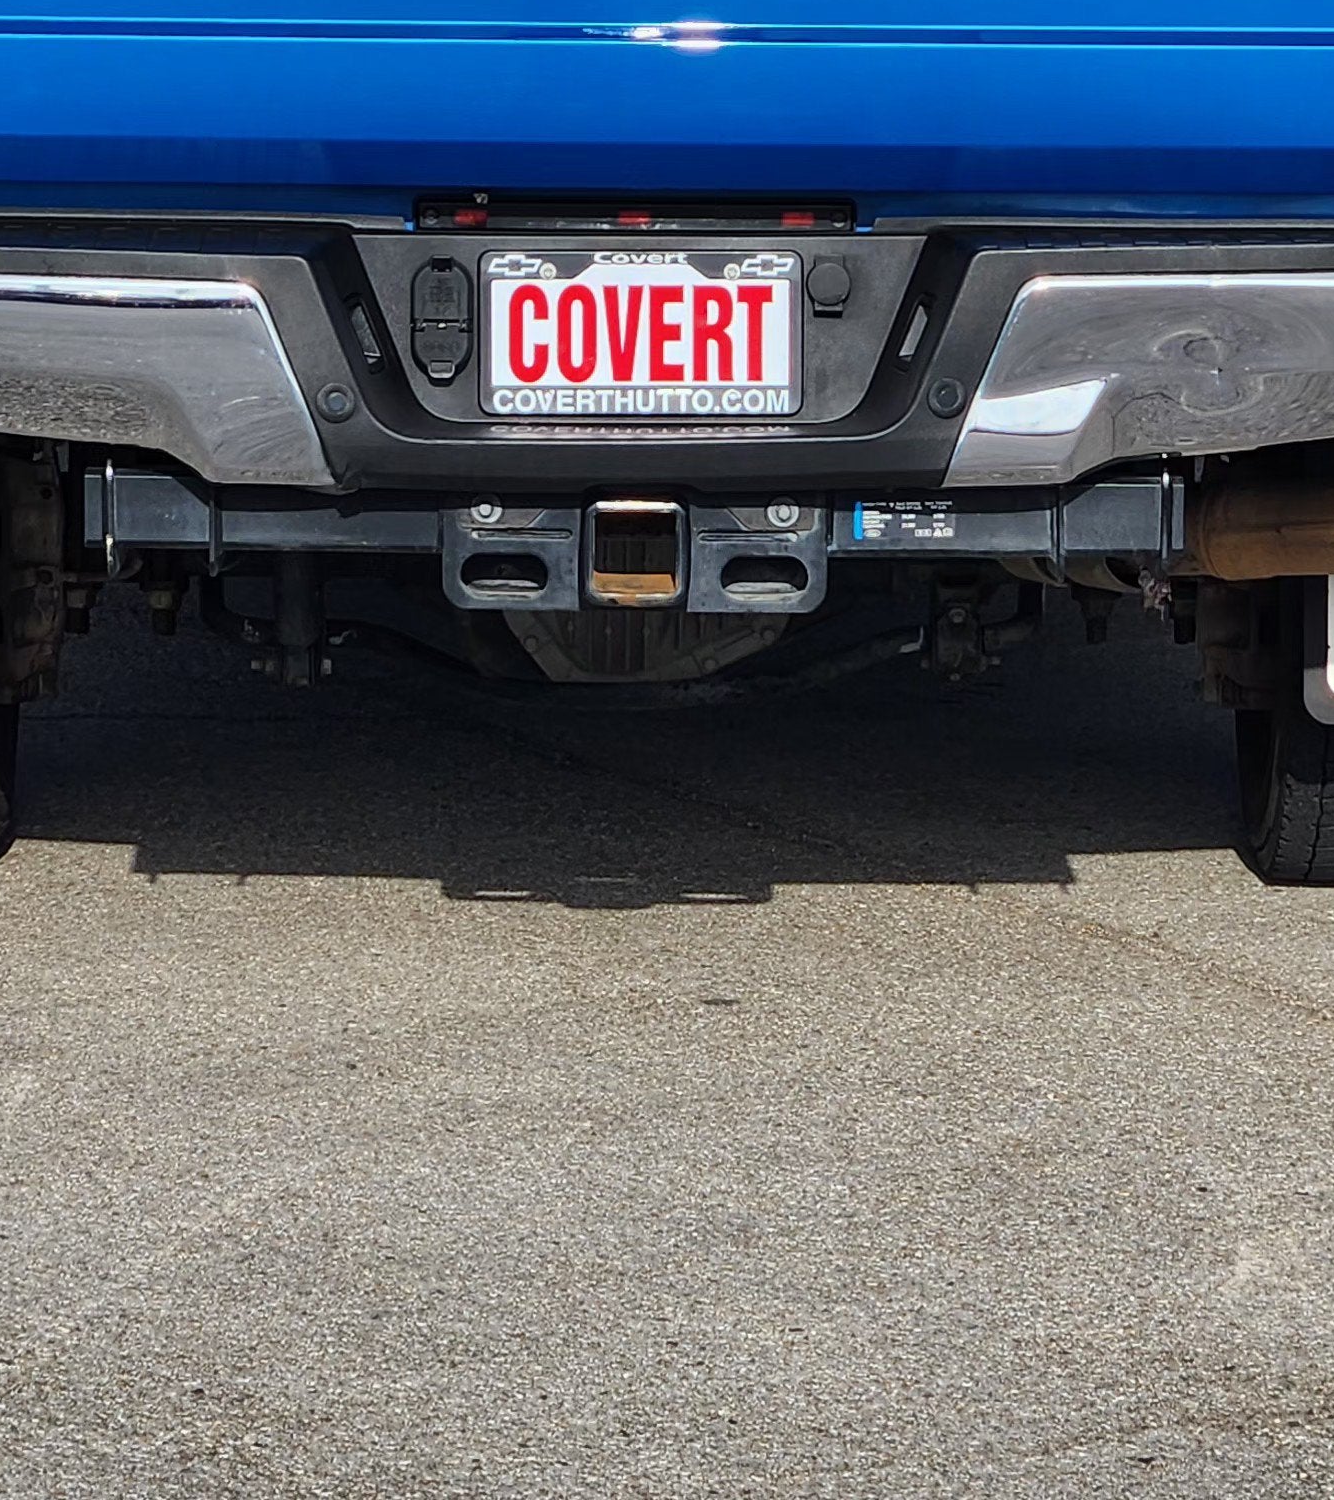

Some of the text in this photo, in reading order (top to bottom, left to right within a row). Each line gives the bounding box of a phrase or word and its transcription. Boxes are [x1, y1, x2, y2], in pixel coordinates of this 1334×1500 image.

[592, 251, 690, 265] Covert
[508, 283, 774, 384] COVERT
[491, 388, 790, 414] COVERTHUTTO.COM
